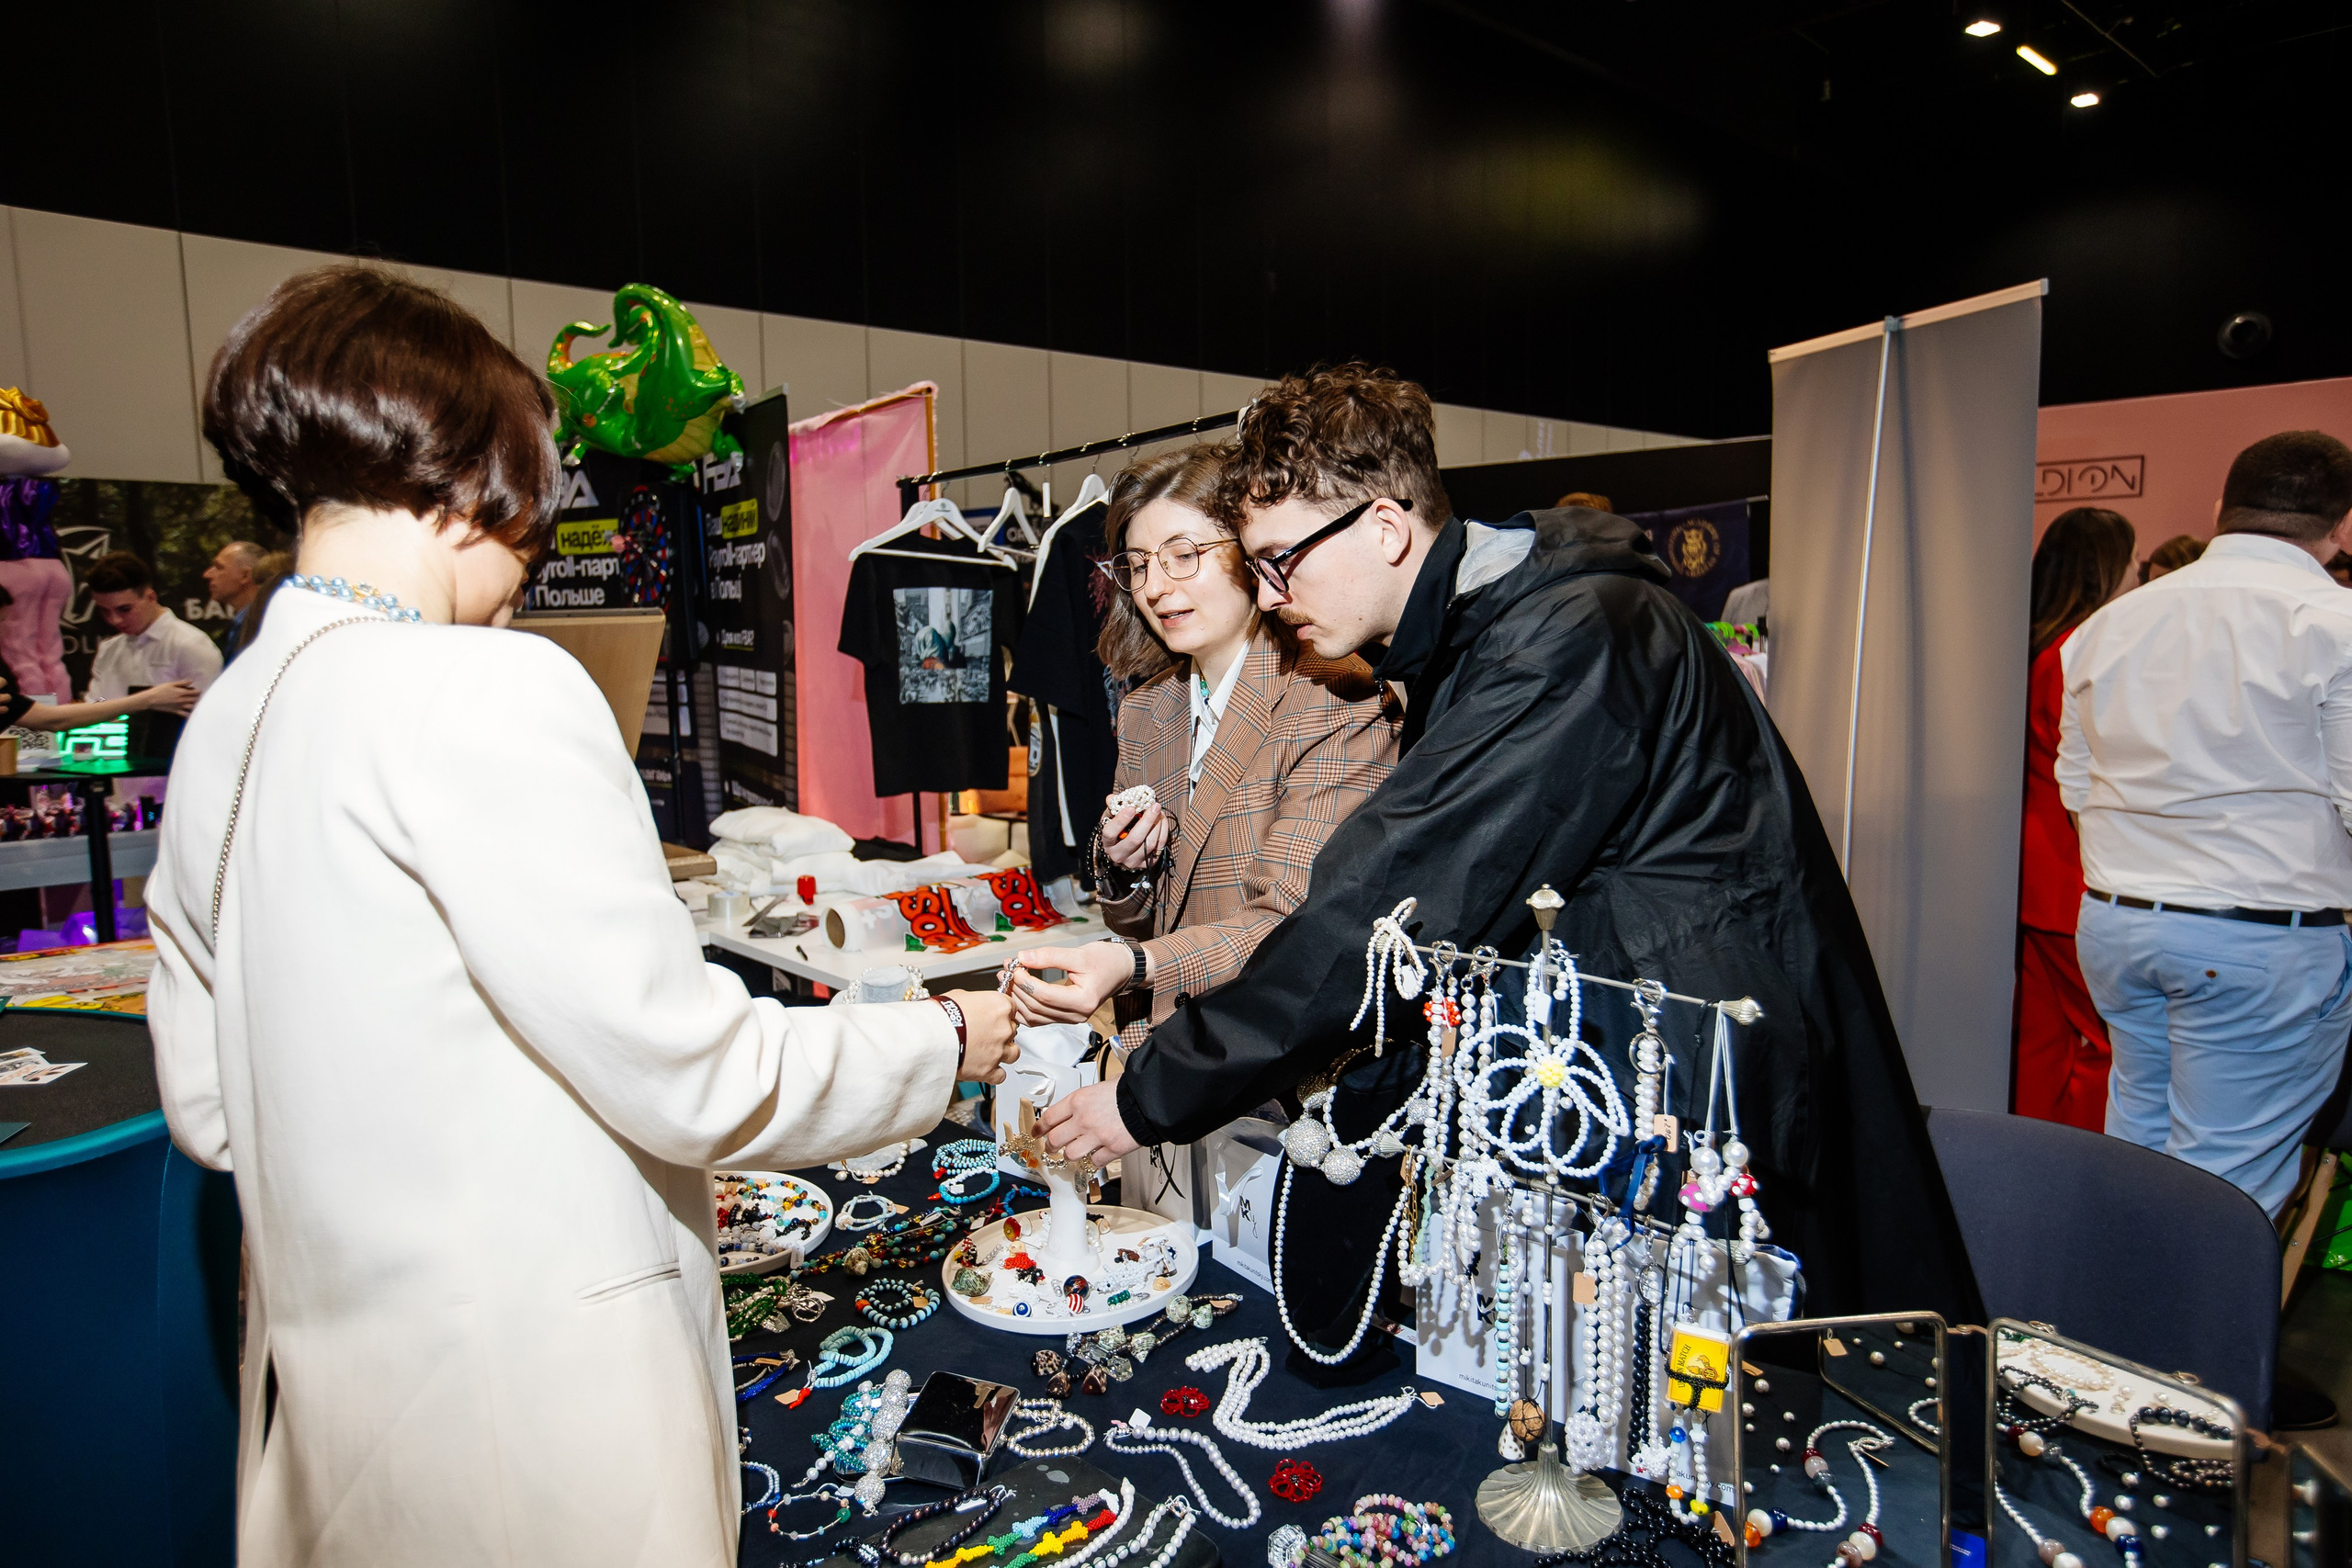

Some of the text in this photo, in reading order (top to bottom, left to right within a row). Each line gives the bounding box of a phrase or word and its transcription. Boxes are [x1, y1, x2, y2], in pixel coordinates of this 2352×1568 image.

[2035, 464, 2136, 496] DION
[1678, 1344, 1691, 1368] MATCH
[1458, 1373, 1498, 1392] mikitakunits
